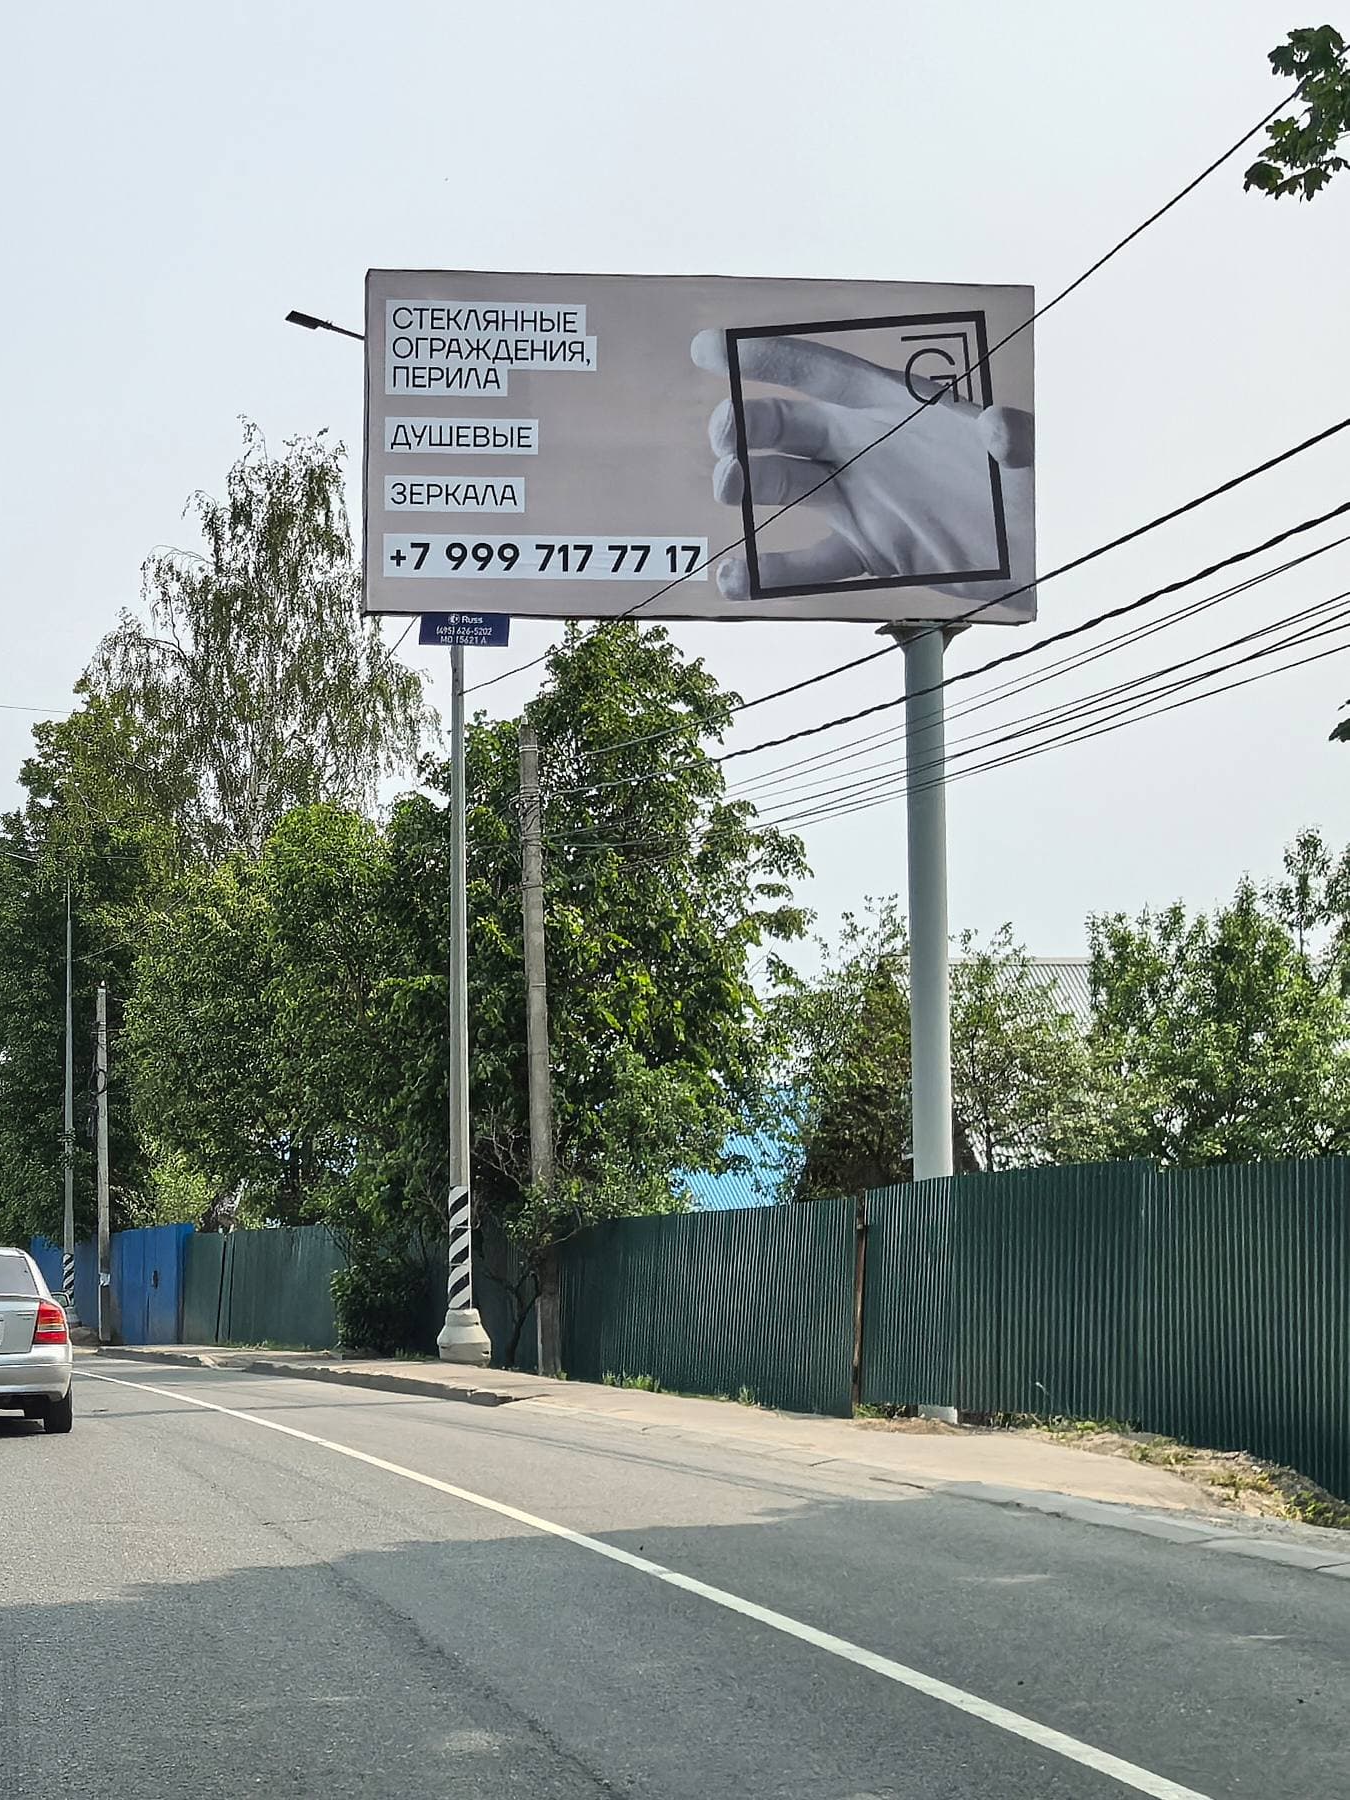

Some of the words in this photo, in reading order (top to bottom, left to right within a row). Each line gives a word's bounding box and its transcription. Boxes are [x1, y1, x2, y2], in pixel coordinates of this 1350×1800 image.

[392, 307, 578, 334] СТЕКЛЯННЫЕ
[392, 336, 591, 365] ОГРАЖДЕНИЯ,
[392, 366, 501, 389] ПЕРИЛА
[391, 424, 533, 449] ДУШЕВЫЕ
[390, 482, 518, 506] ЗЕРКАЛА
[390, 542, 431, 571] +7
[445, 542, 520, 572] 999
[535, 543, 593, 572] 717
[608, 544, 651, 573] 77
[665, 545, 701, 573] 17
[436, 625, 455, 636] (495)
[461, 615, 483, 624] Russ
